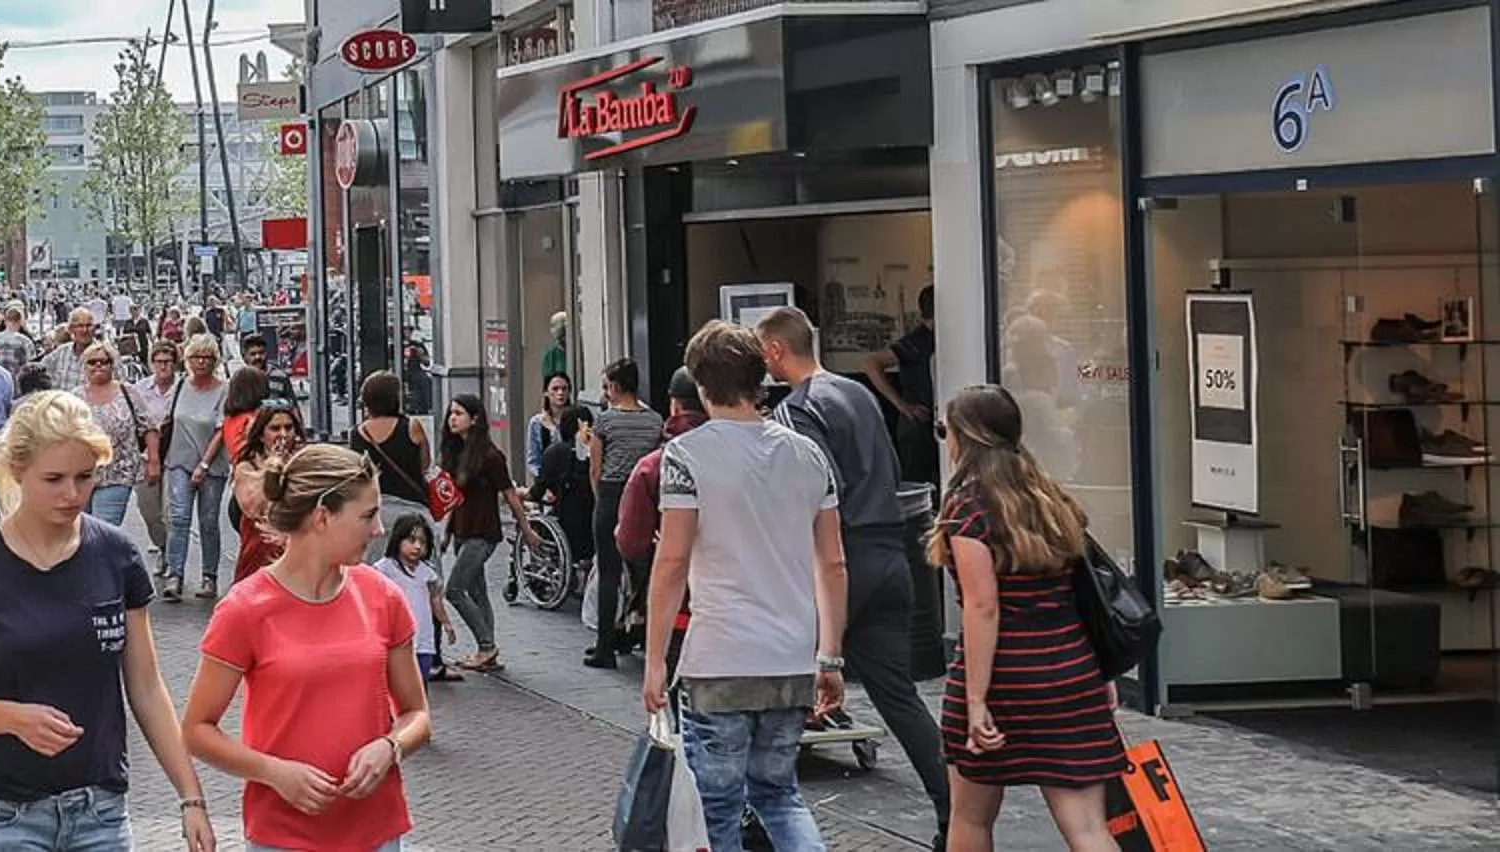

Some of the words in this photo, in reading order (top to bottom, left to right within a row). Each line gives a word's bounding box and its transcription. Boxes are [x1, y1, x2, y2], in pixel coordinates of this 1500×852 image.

[350, 38, 414, 62] SCORE
[243, 92, 296, 110] Steps
[567, 91, 592, 136] La
[595, 81, 676, 133] Bamba
[1206, 369, 1236, 390] 50%
